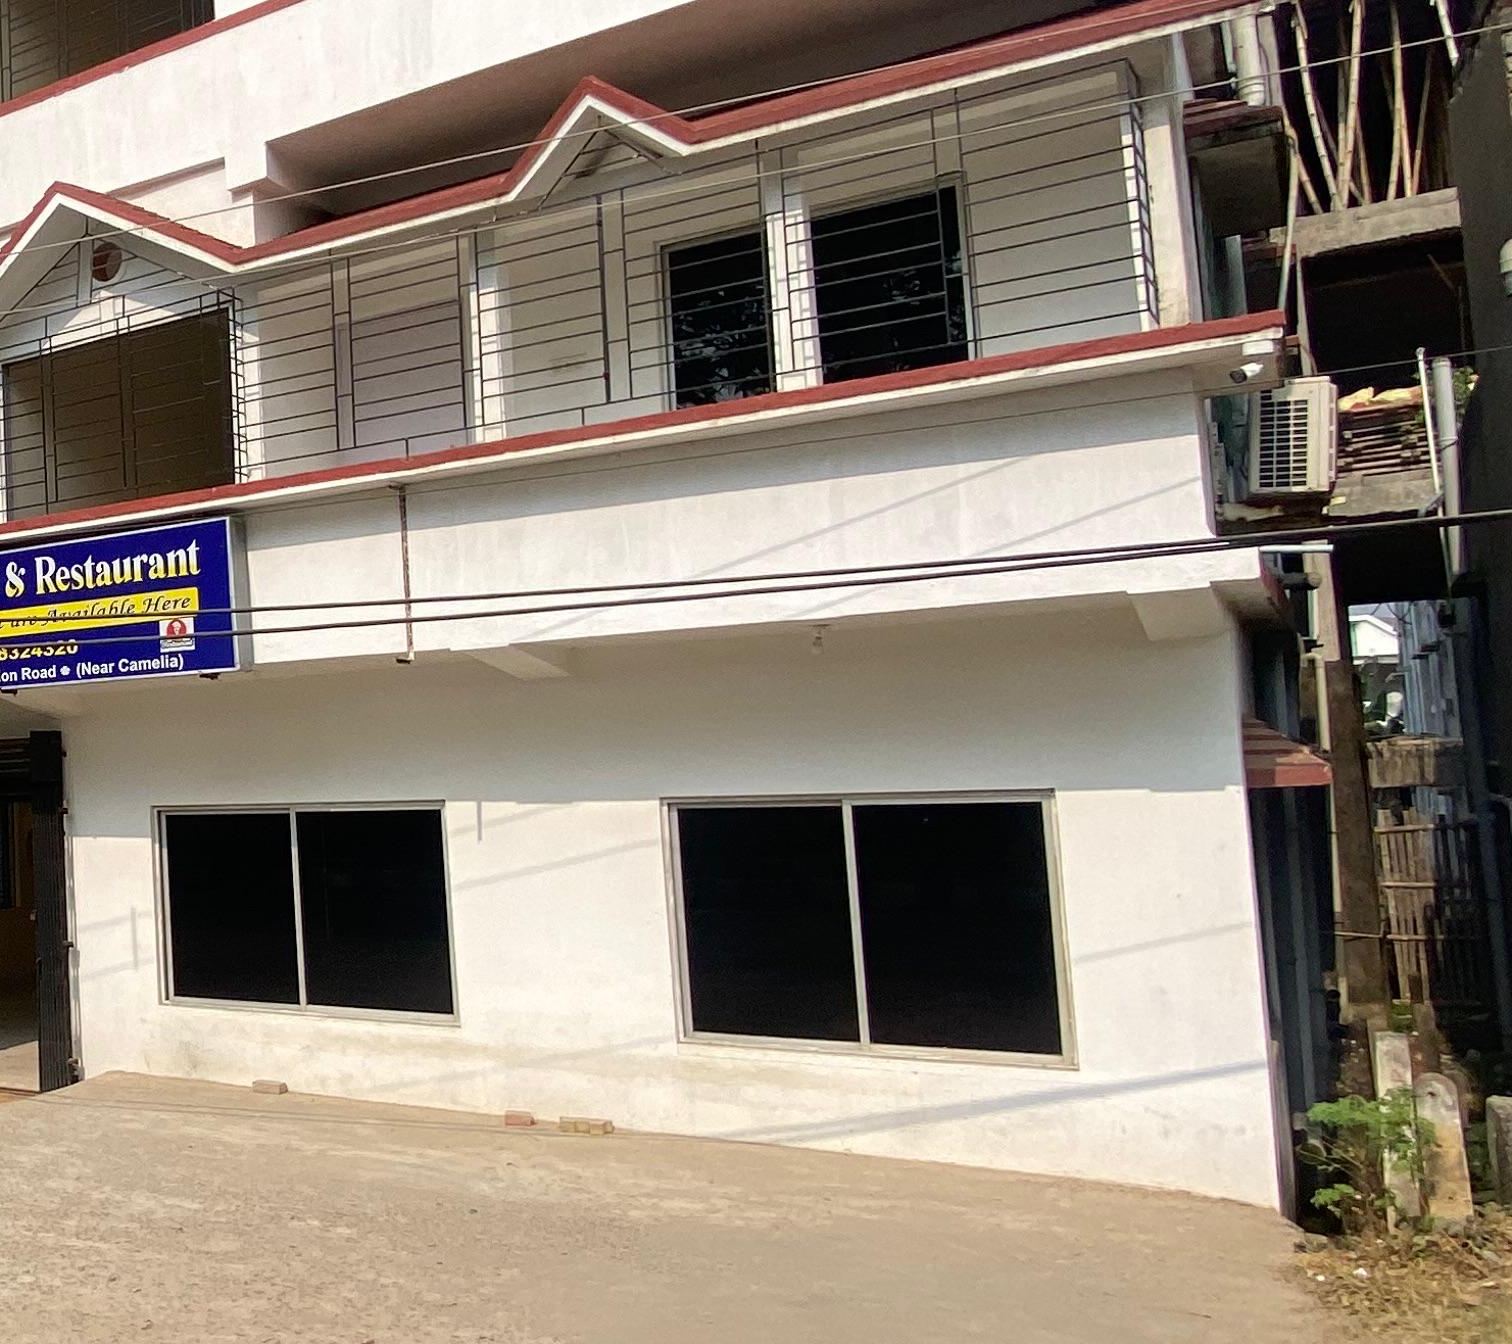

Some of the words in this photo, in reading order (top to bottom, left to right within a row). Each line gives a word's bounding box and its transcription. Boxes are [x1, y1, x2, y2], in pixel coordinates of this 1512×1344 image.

[4, 561, 26, 598] &
[34, 538, 201, 595] Restaurant
[142, 595, 191, 614] Here
[20, 664, 57, 681] Road
[75, 662, 115, 679] (Near
[118, 654, 185, 673] Camelia)
